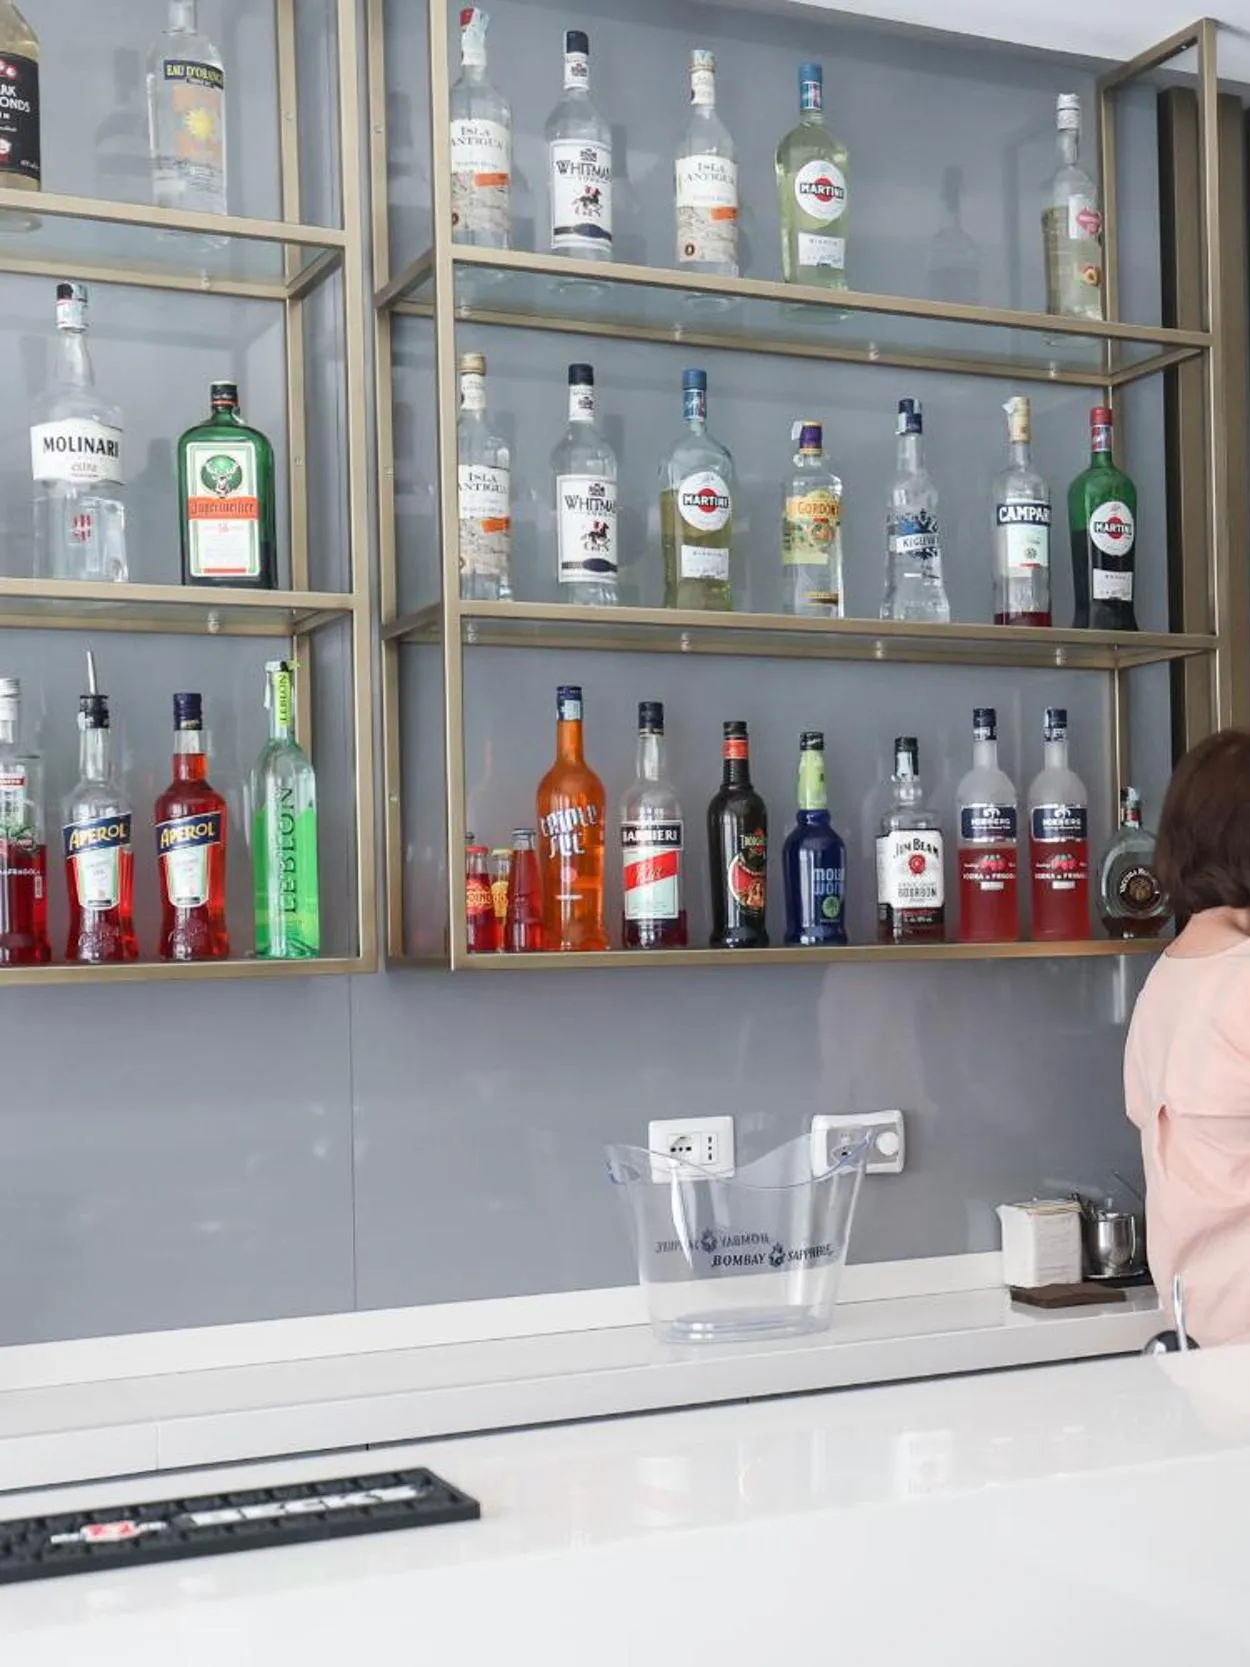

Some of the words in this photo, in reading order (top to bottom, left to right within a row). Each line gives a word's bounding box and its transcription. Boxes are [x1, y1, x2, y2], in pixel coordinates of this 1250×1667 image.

[800, 183, 844, 199] MARTINI
[43, 436, 119, 458] MOLINARI
[683, 493, 729, 509] MARTINI
[999, 506, 1051, 523] CAMPAR
[1094, 521, 1133, 536] MARTINI
[70, 823, 127, 850] APEROL
[161, 821, 216, 848] APEROL
[280, 786, 297, 913] LEBLON
[711, 1252, 767, 1268] BOMBAY
